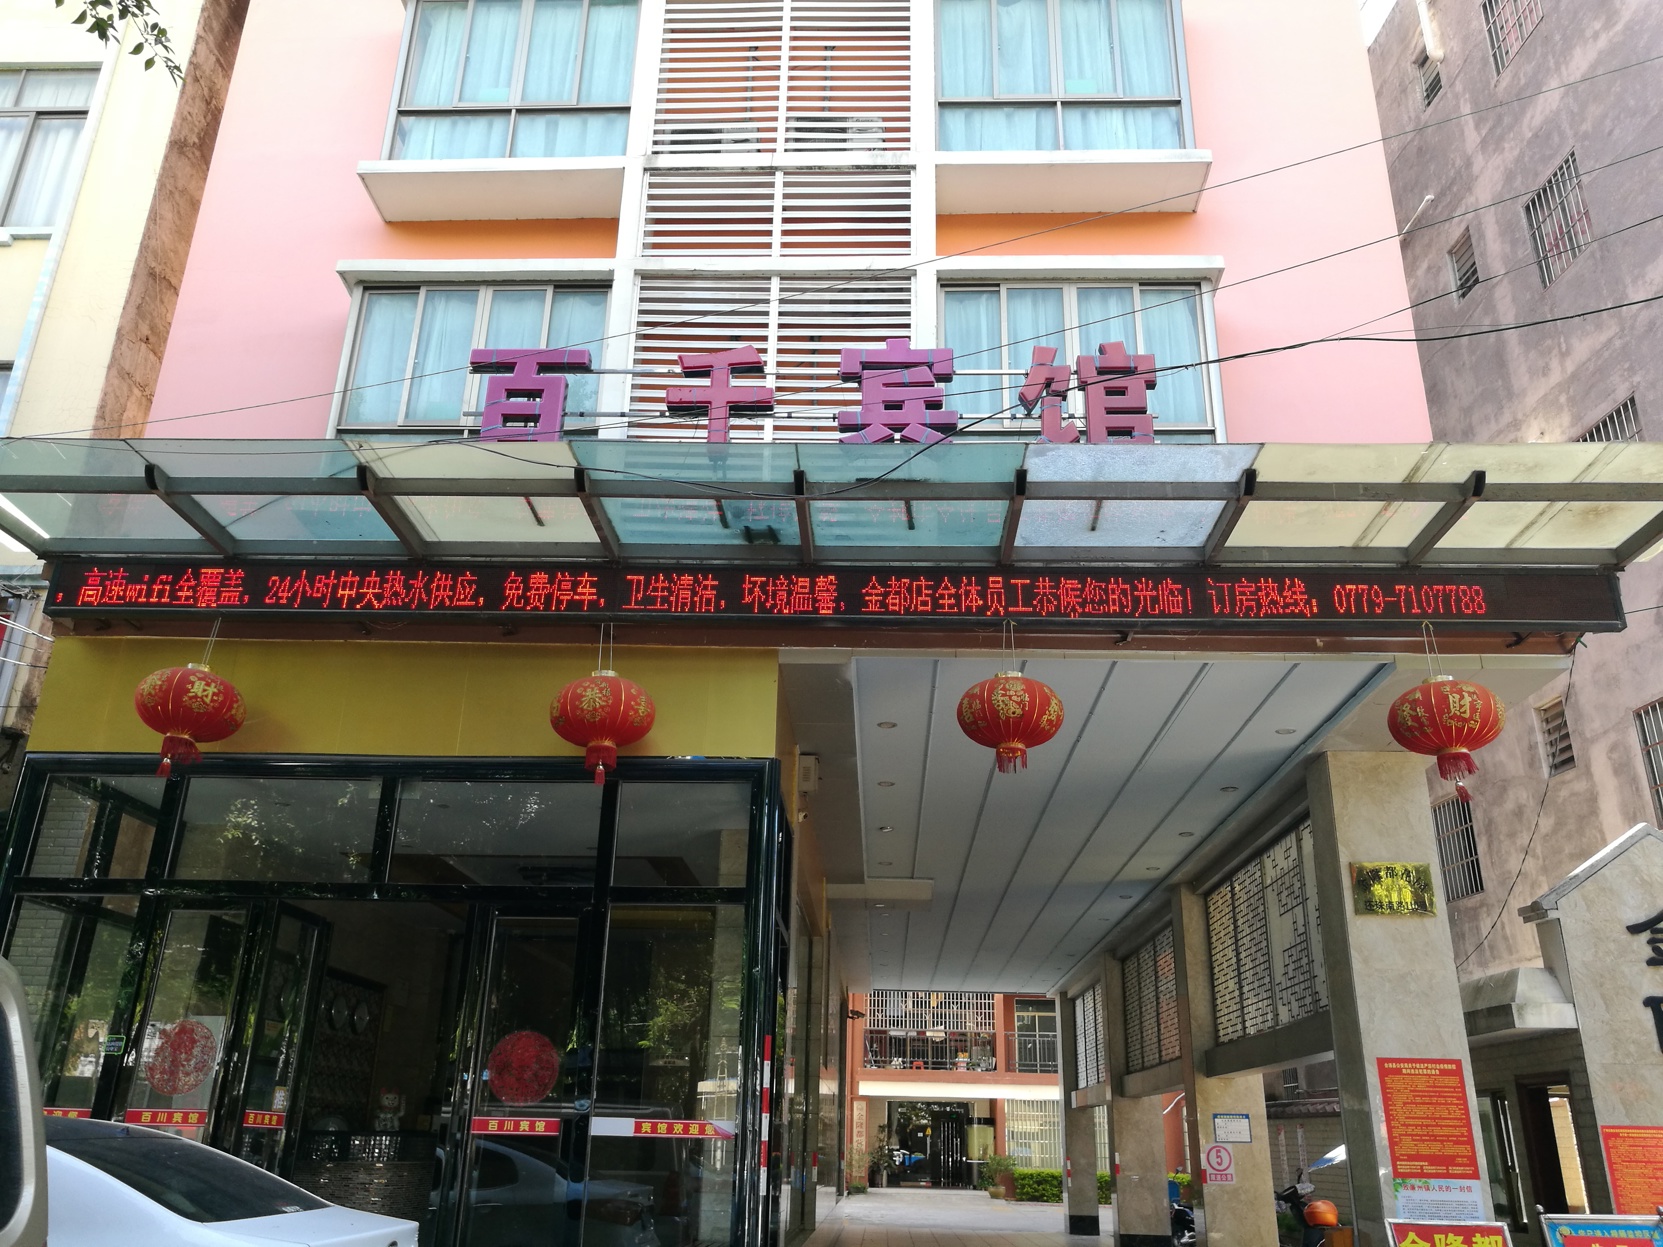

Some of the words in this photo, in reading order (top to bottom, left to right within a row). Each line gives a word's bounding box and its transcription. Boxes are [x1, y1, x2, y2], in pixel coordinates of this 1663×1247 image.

[141, 1112, 199, 1123] 百川宾馆
[248, 1113, 278, 1125] 百川宾馆
[488, 1120, 546, 1132] 百川宾馆
[641, 1120, 715, 1135] 宾馆欢迎您
[1215, 1149, 1223, 1166] 5
